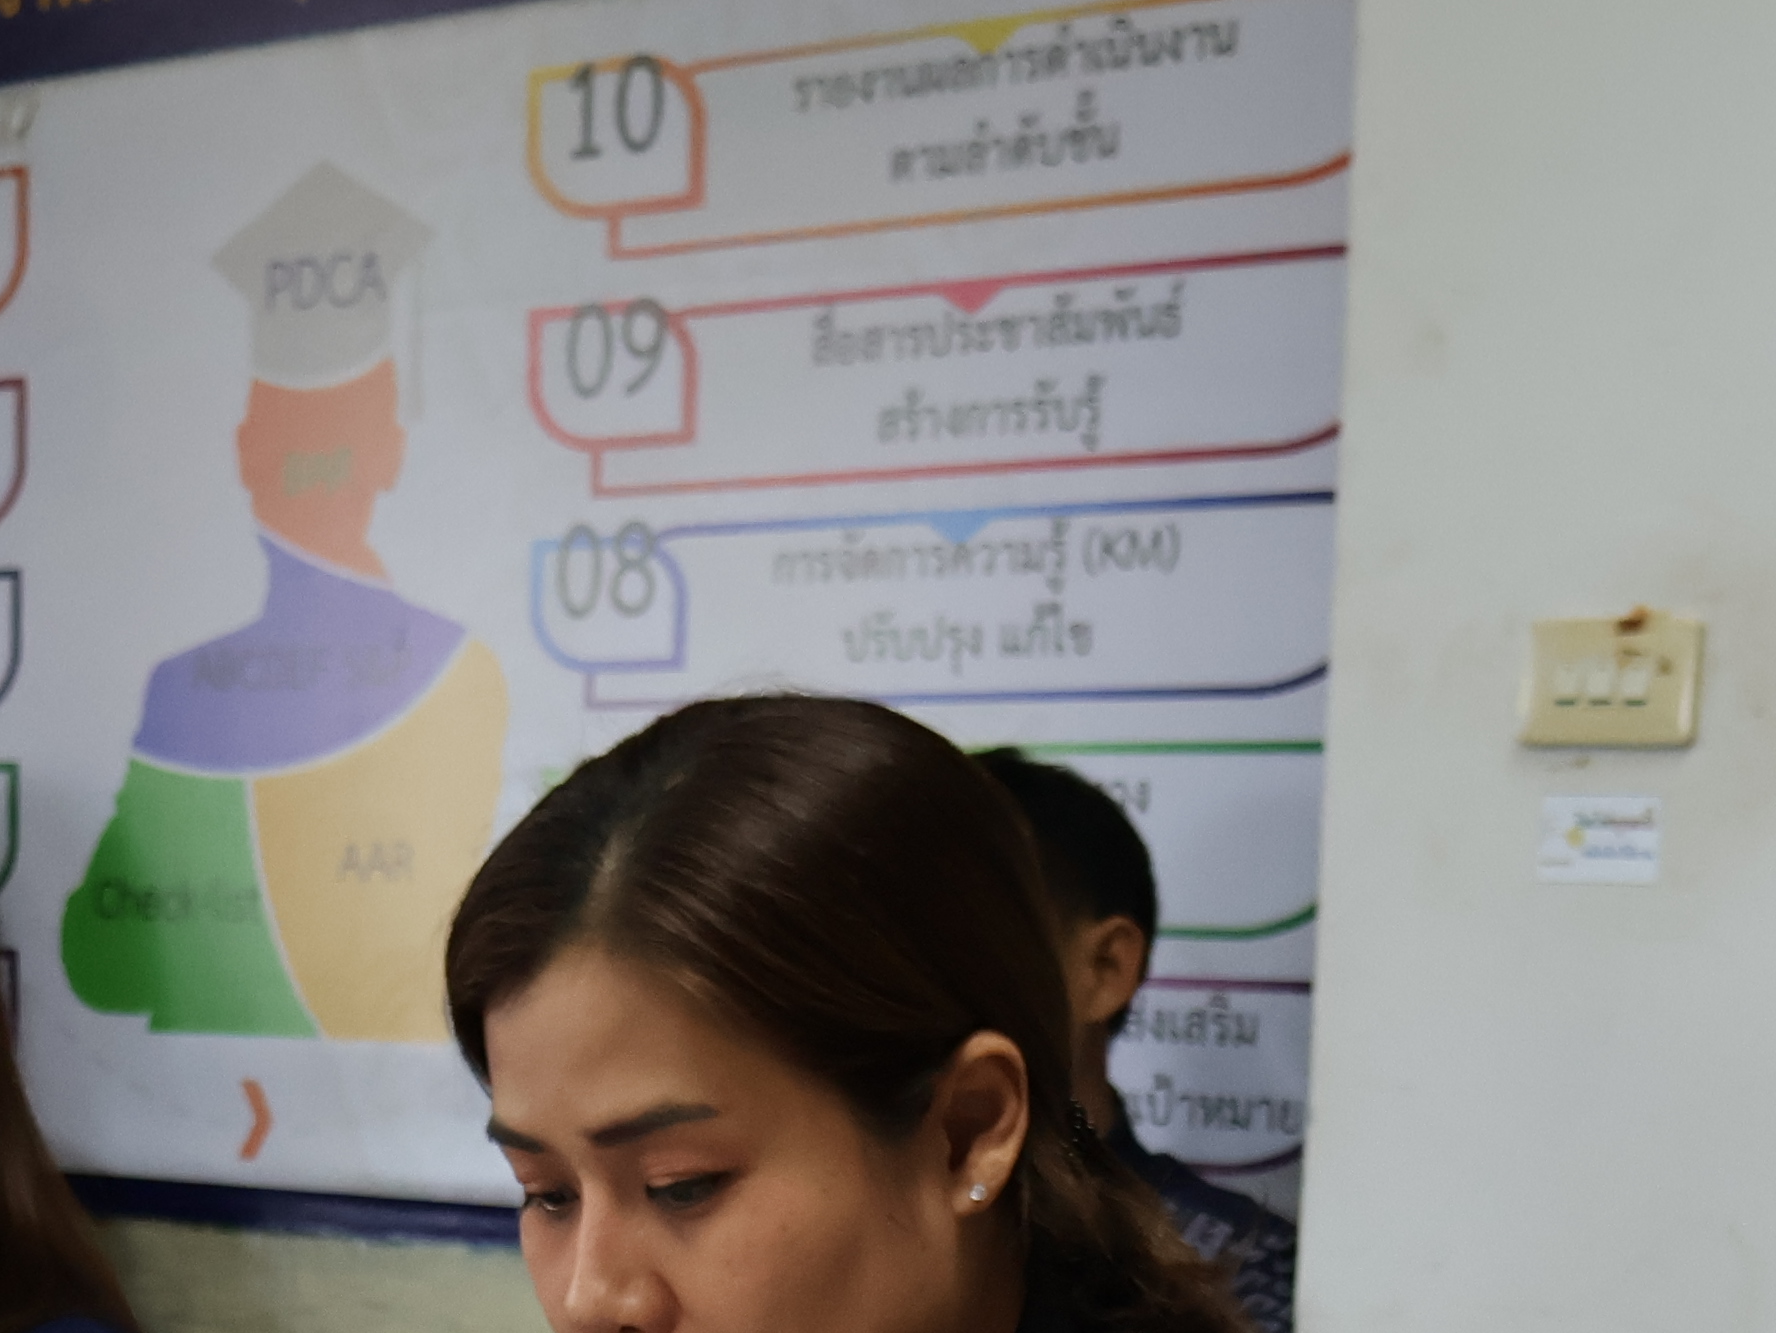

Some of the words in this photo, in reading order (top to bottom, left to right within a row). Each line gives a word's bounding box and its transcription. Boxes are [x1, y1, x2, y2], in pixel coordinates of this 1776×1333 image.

[567, 53, 667, 162] 10
[264, 252, 388, 312] PDCA
[565, 298, 667, 399] 09
[555, 520, 658, 622] 08
[1082, 523, 1181, 579] (KM)
[339, 845, 412, 884] AAR
[94, 876, 194, 924] Check
